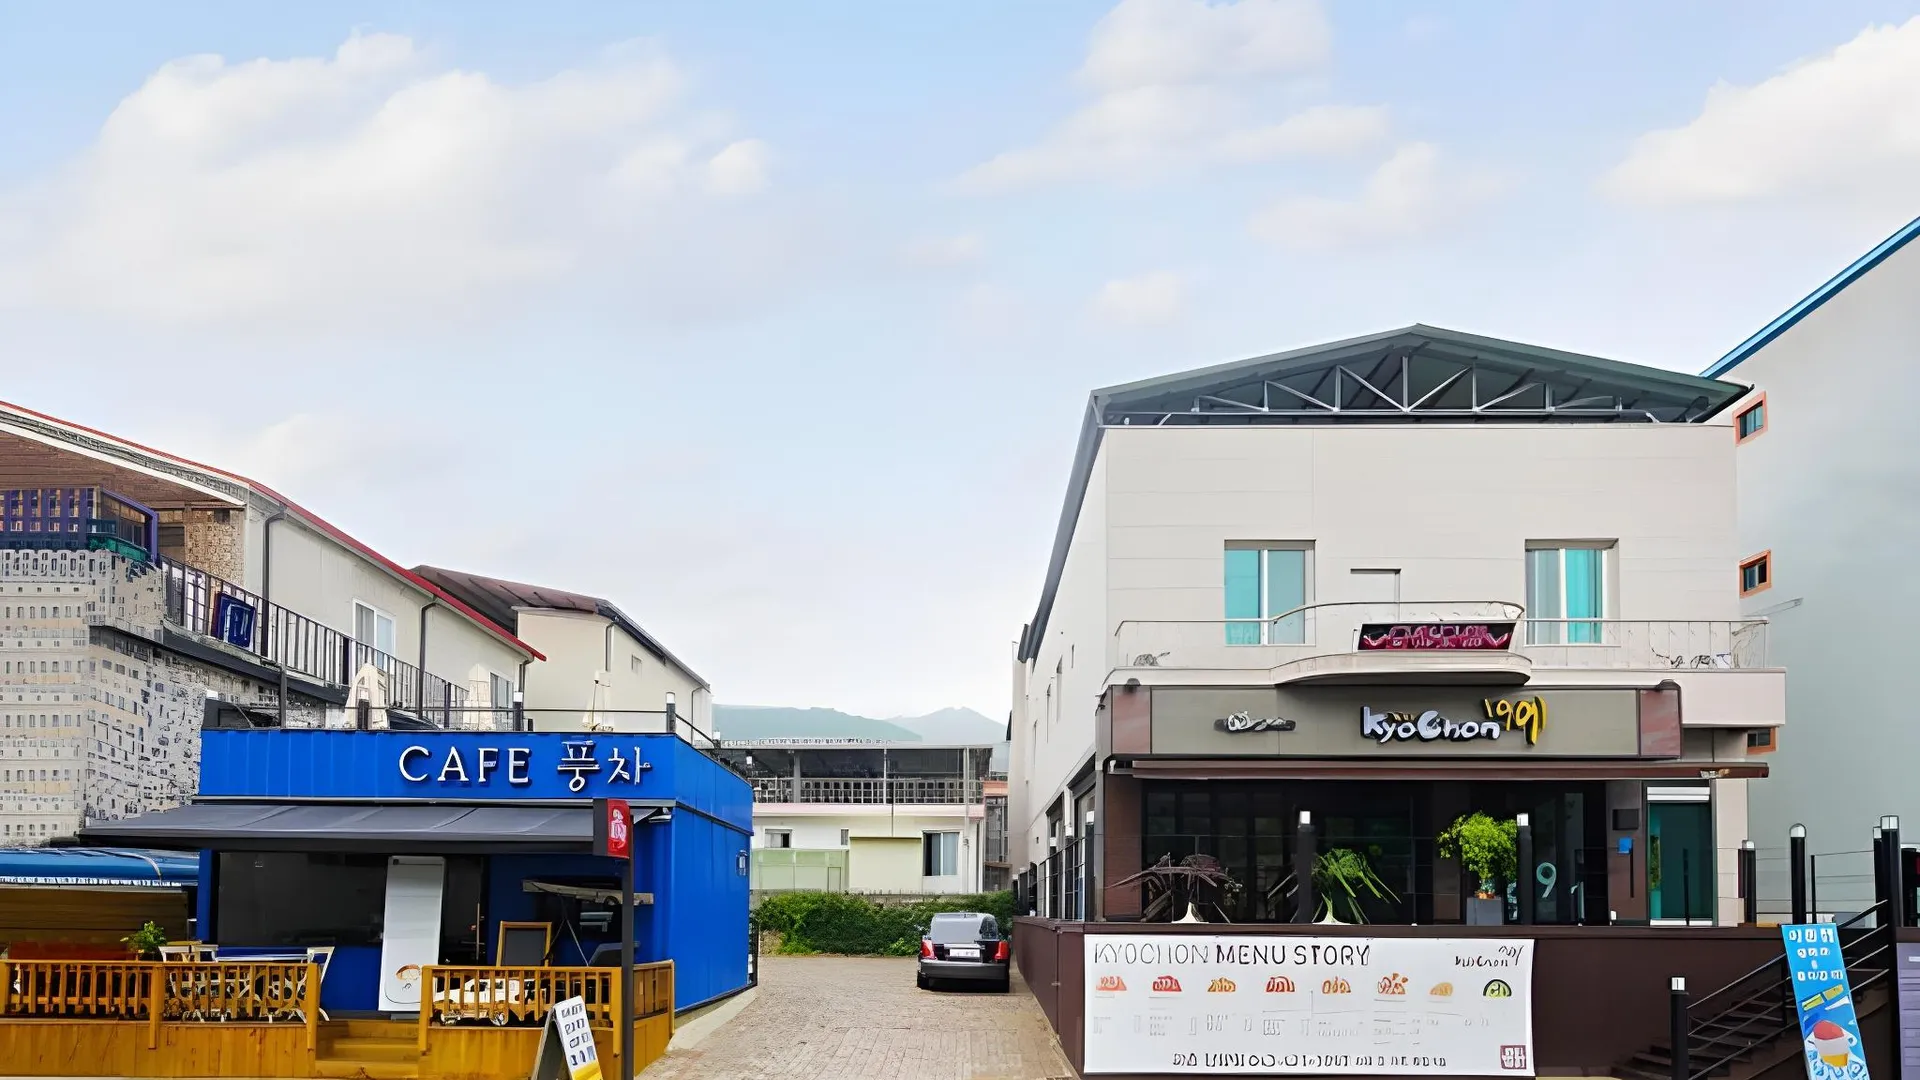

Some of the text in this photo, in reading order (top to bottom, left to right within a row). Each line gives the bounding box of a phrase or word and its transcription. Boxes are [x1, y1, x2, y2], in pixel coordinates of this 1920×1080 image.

[399, 740, 652, 792] CAFE 풍차
[1216, 944, 1287, 966] MENU
[1294, 944, 1371, 966] STORY
